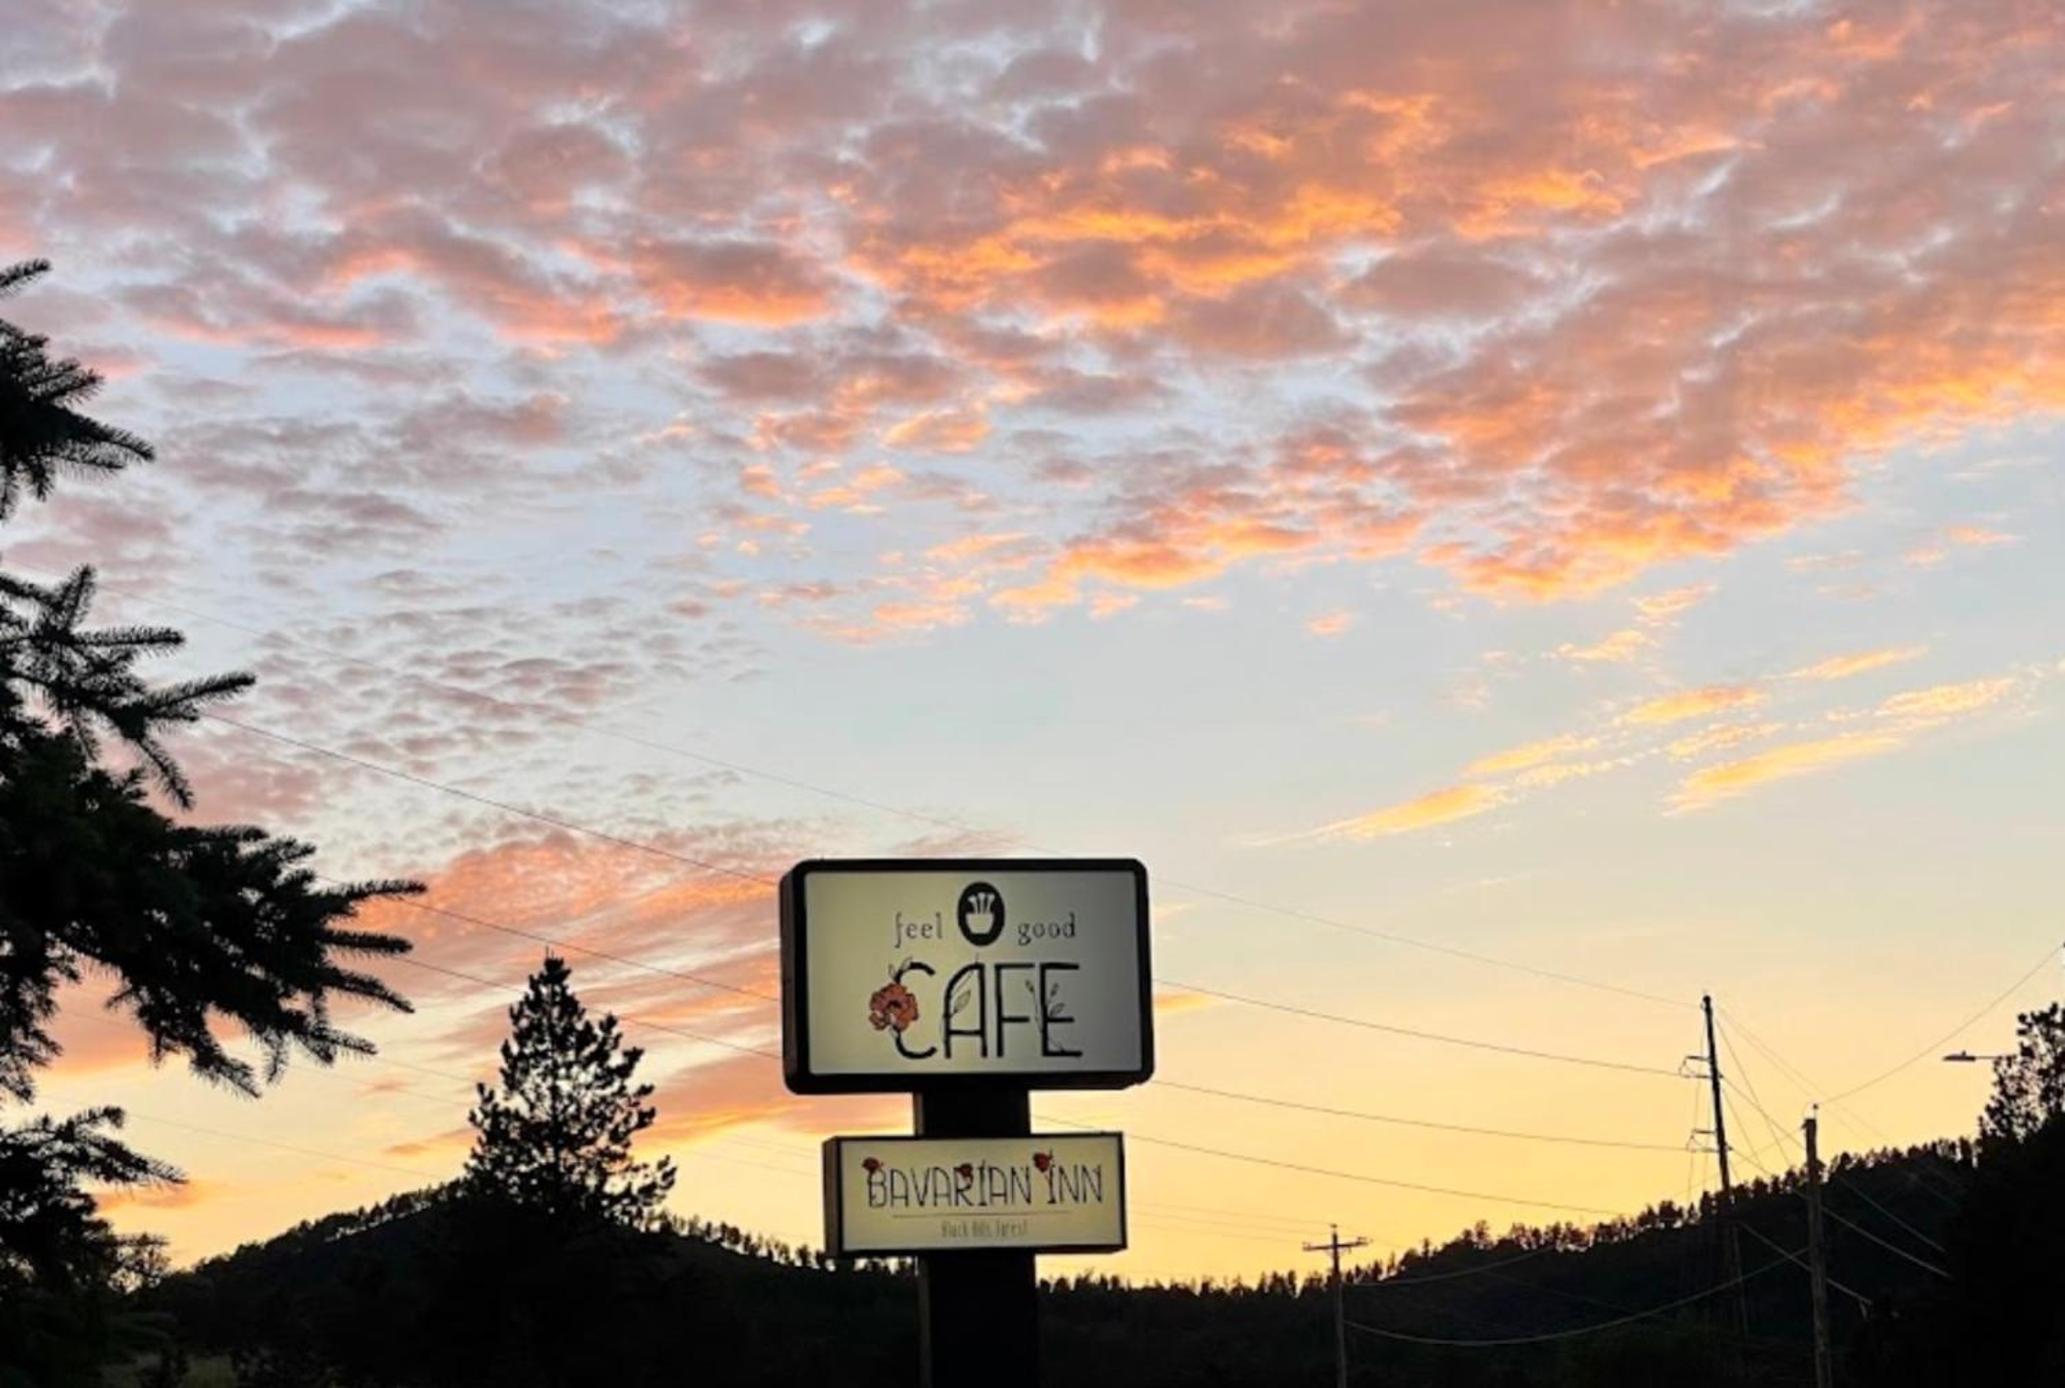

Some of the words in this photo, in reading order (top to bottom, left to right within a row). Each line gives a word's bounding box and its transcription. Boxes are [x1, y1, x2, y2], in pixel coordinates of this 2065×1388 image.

[894, 911, 943, 948] feel
[1017, 911, 1076, 946] good
[890, 959, 1083, 1059] CAFE
[866, 1163, 1032, 1208] BAVARIAN
[1046, 1156, 1103, 1204] INN
